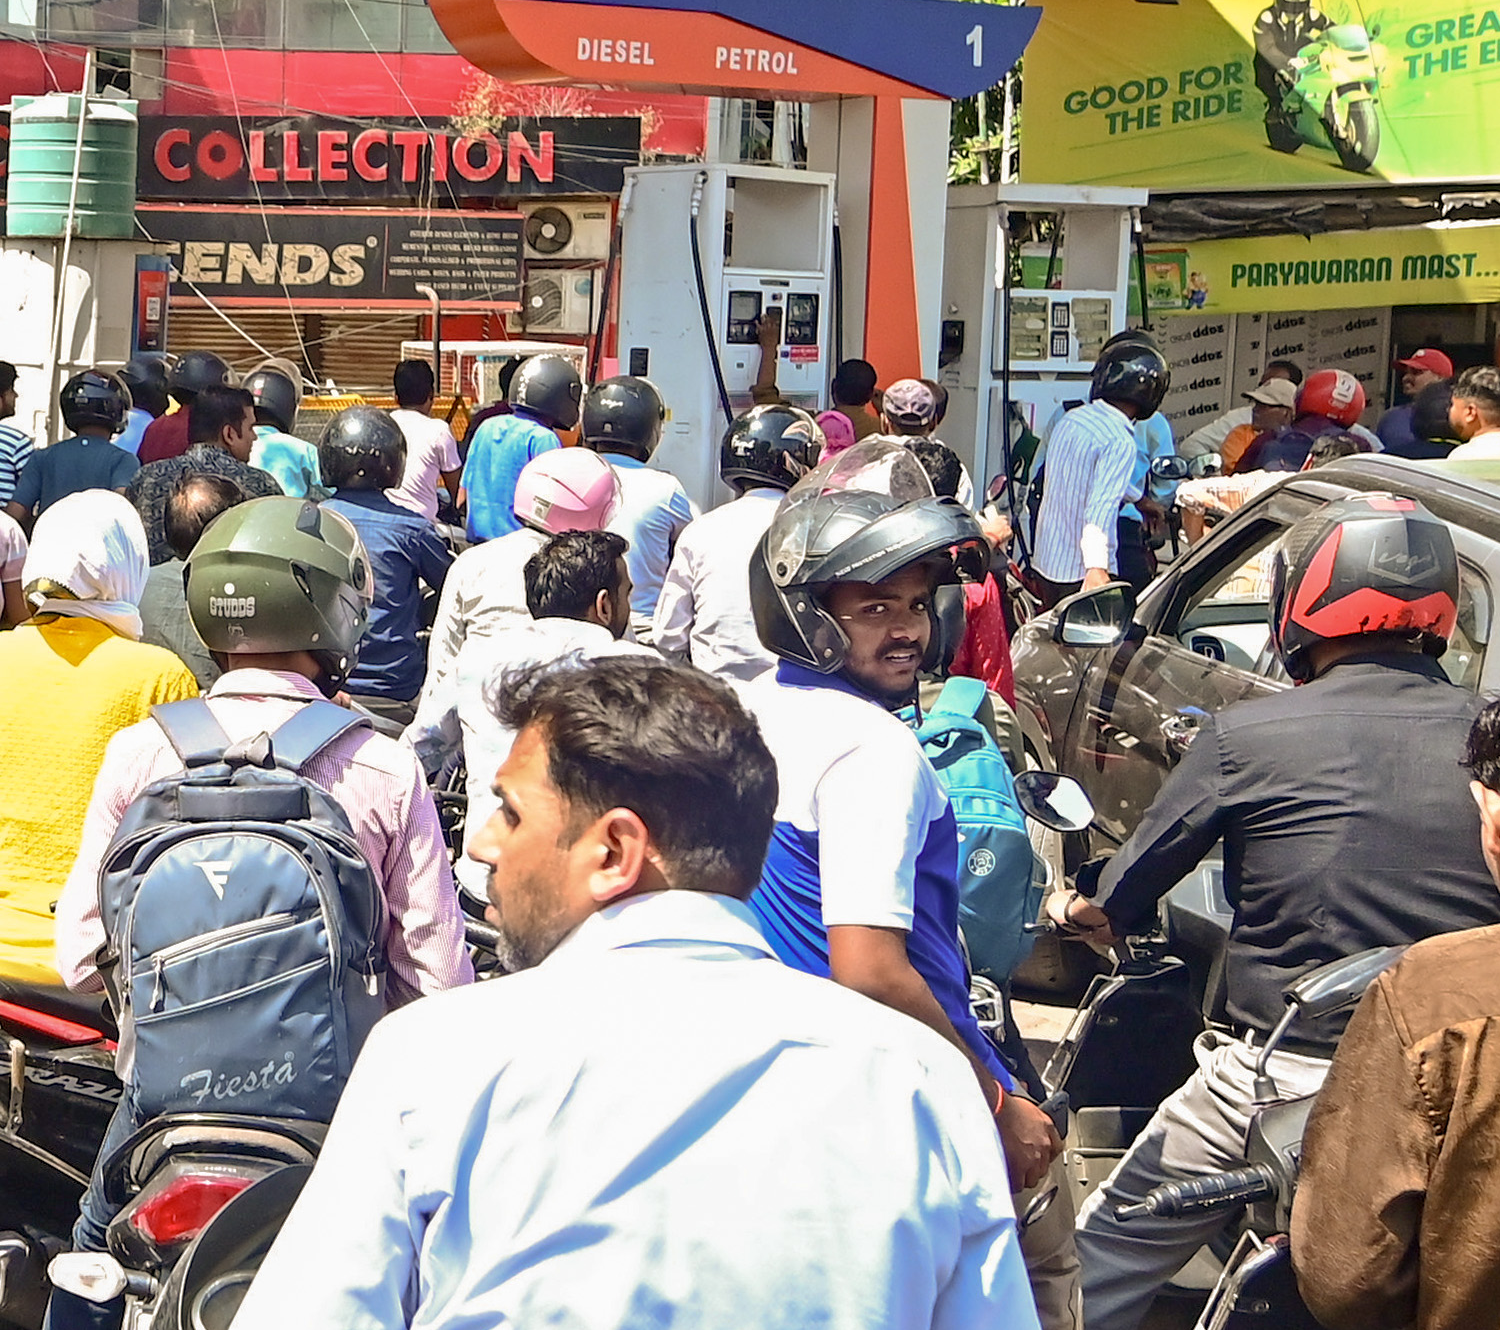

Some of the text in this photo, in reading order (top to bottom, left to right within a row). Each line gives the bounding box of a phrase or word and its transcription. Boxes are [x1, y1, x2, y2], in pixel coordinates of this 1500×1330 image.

[576, 23, 984, 75] DIESEL PETROL 1
[1404, 45, 1468, 81] THE
[1063, 62, 1245, 116] GOOD FOR
[1104, 89, 1244, 136] THE RIDE
[154, 126, 555, 184] COLLECTION
[1230, 256, 1393, 289] PARYAVARAN
[209, 596, 256, 618] STUDDS
[179, 1059, 298, 1107] Fiesta
